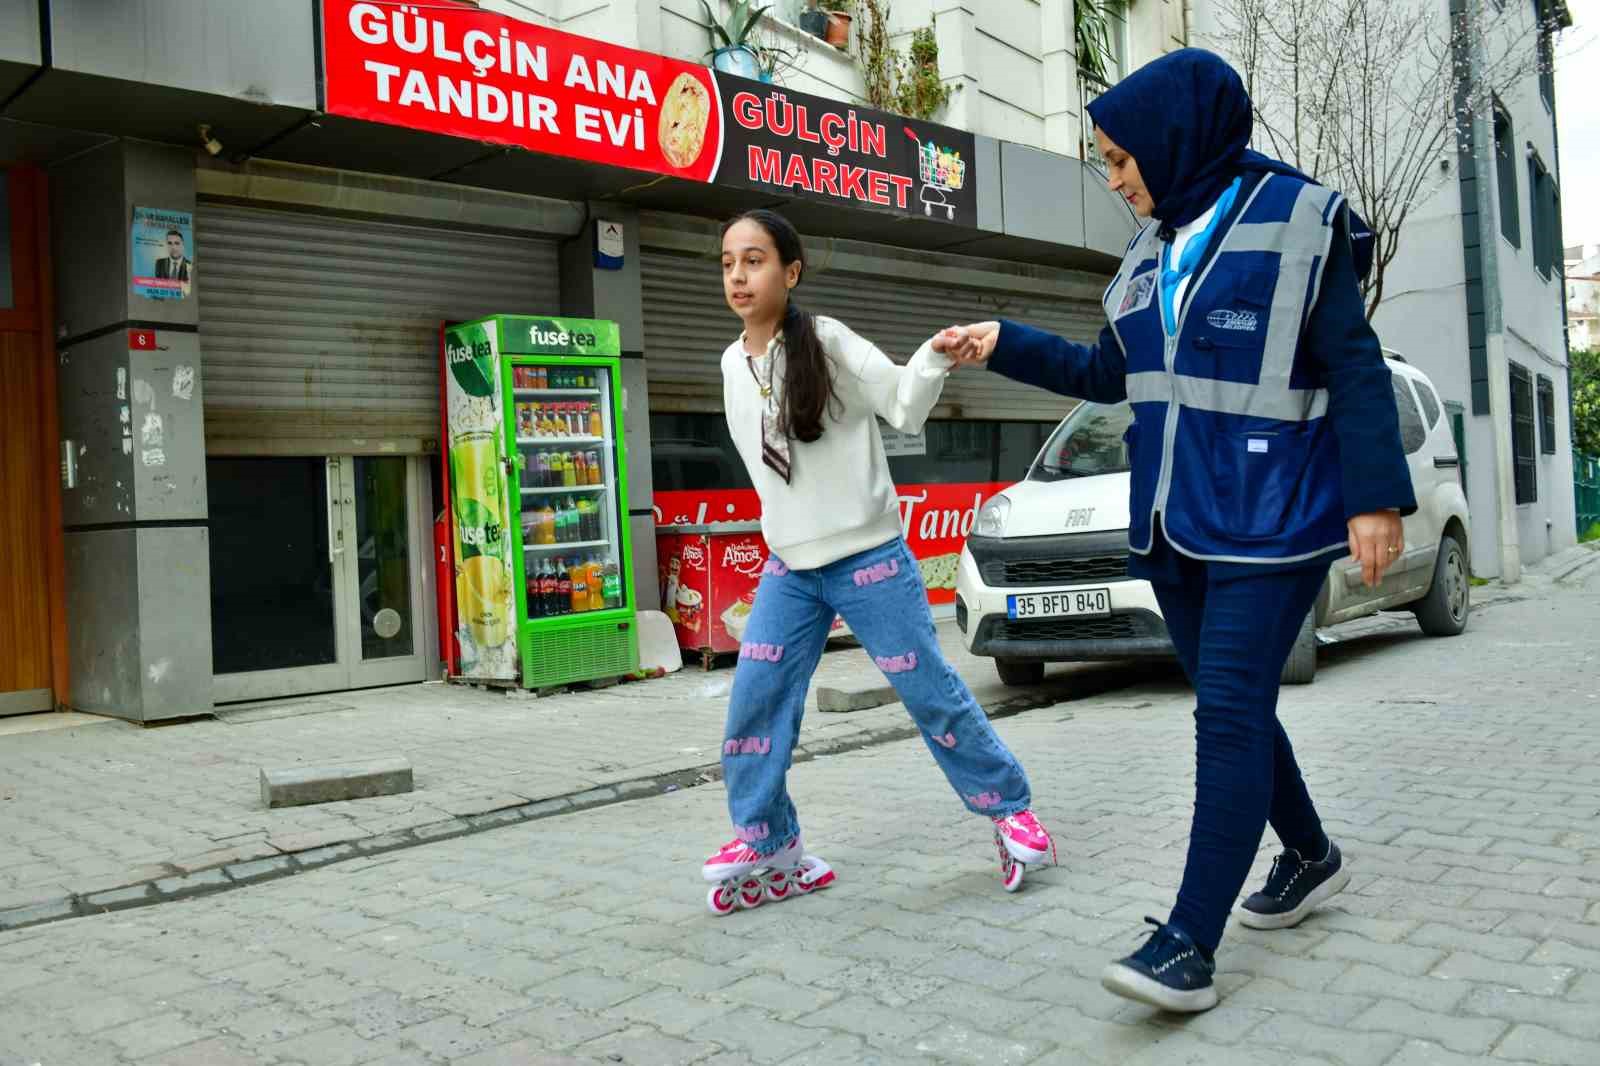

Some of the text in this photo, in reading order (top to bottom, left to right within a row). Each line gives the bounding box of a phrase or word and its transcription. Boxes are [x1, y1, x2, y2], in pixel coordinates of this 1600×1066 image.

[349, 3, 657, 106] GÜLÇİN ANA
[364, 60, 645, 151] TANDIR EVİ
[732, 91, 887, 158] GÜLÇİN
[748, 145, 913, 209] MARKET
[1064, 507, 1096, 528] FIAT
[1018, 597, 1036, 616] 35
[1042, 594, 1070, 614] BFD
[1076, 592, 1105, 611] 840
